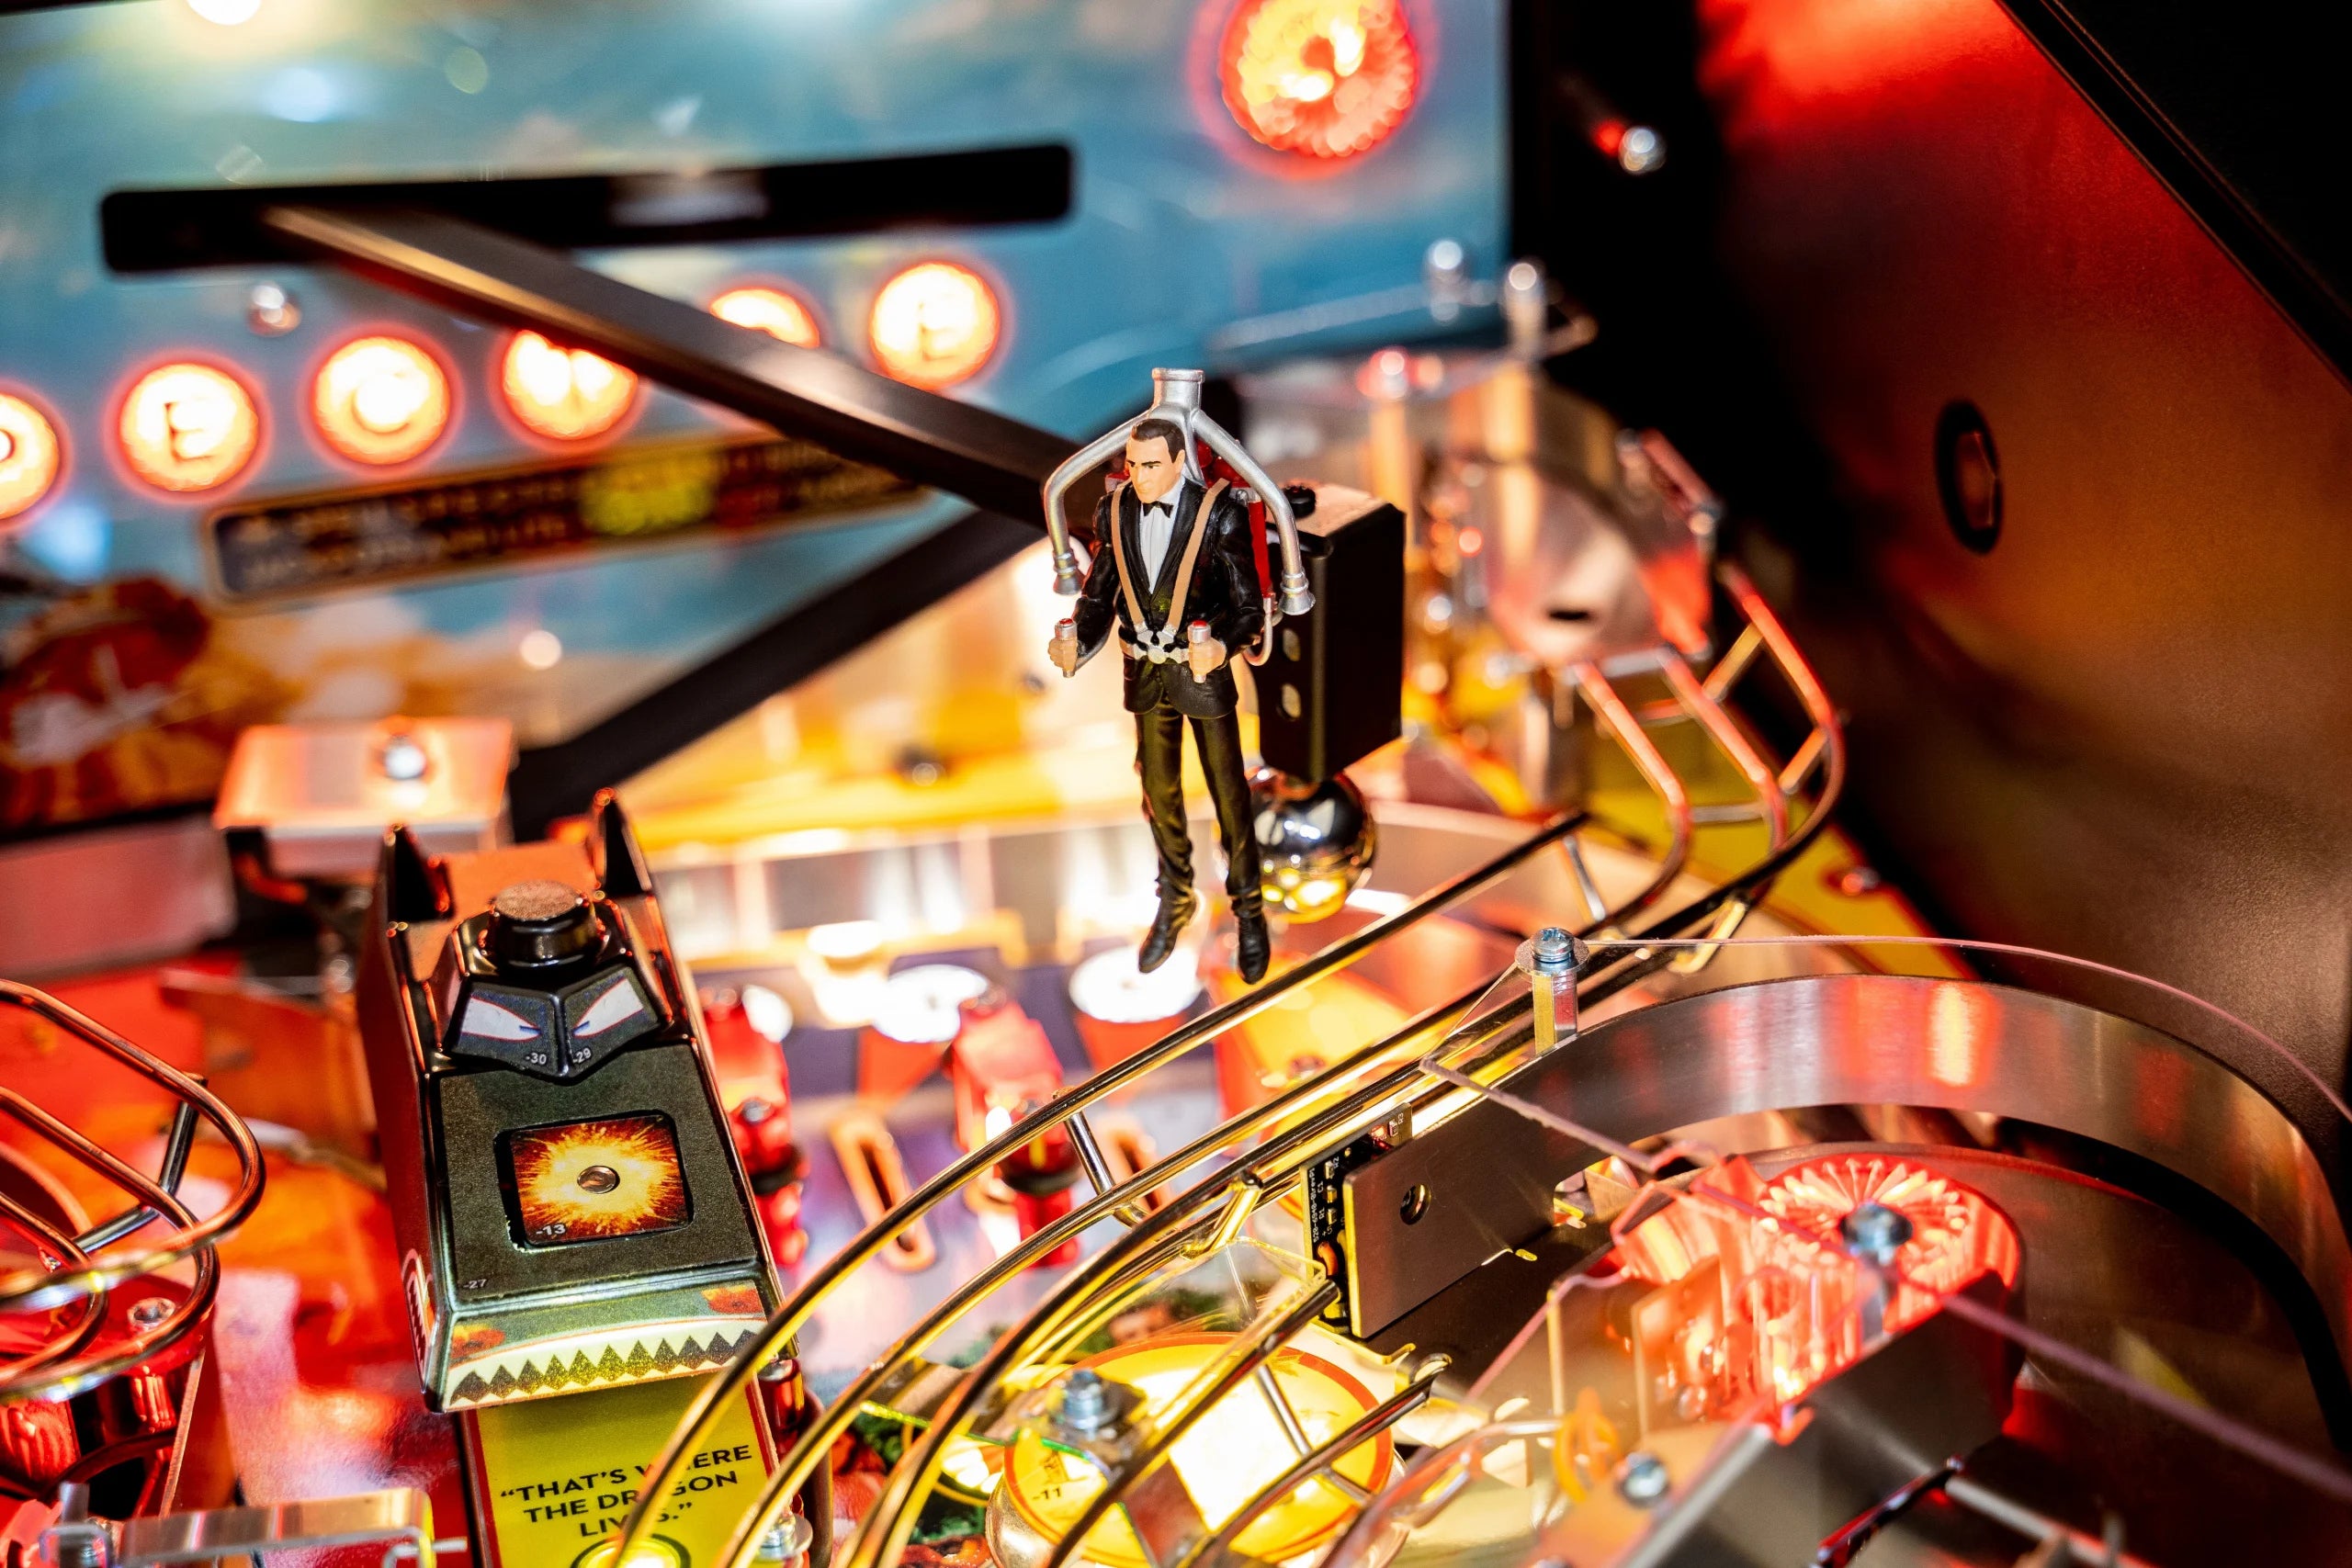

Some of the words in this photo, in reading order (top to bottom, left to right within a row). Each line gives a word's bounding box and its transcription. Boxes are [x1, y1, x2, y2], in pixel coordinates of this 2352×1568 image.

[526, 1052, 548, 1065] -30
[572, 1047, 593, 1064] -29
[536, 1224, 566, 1235] -13
[462, 1279, 487, 1289] -27
[501, 1469, 628, 1501] “THAT’S
[524, 1499, 589, 1523] THE
[598, 1471, 739, 1509] DRGON
